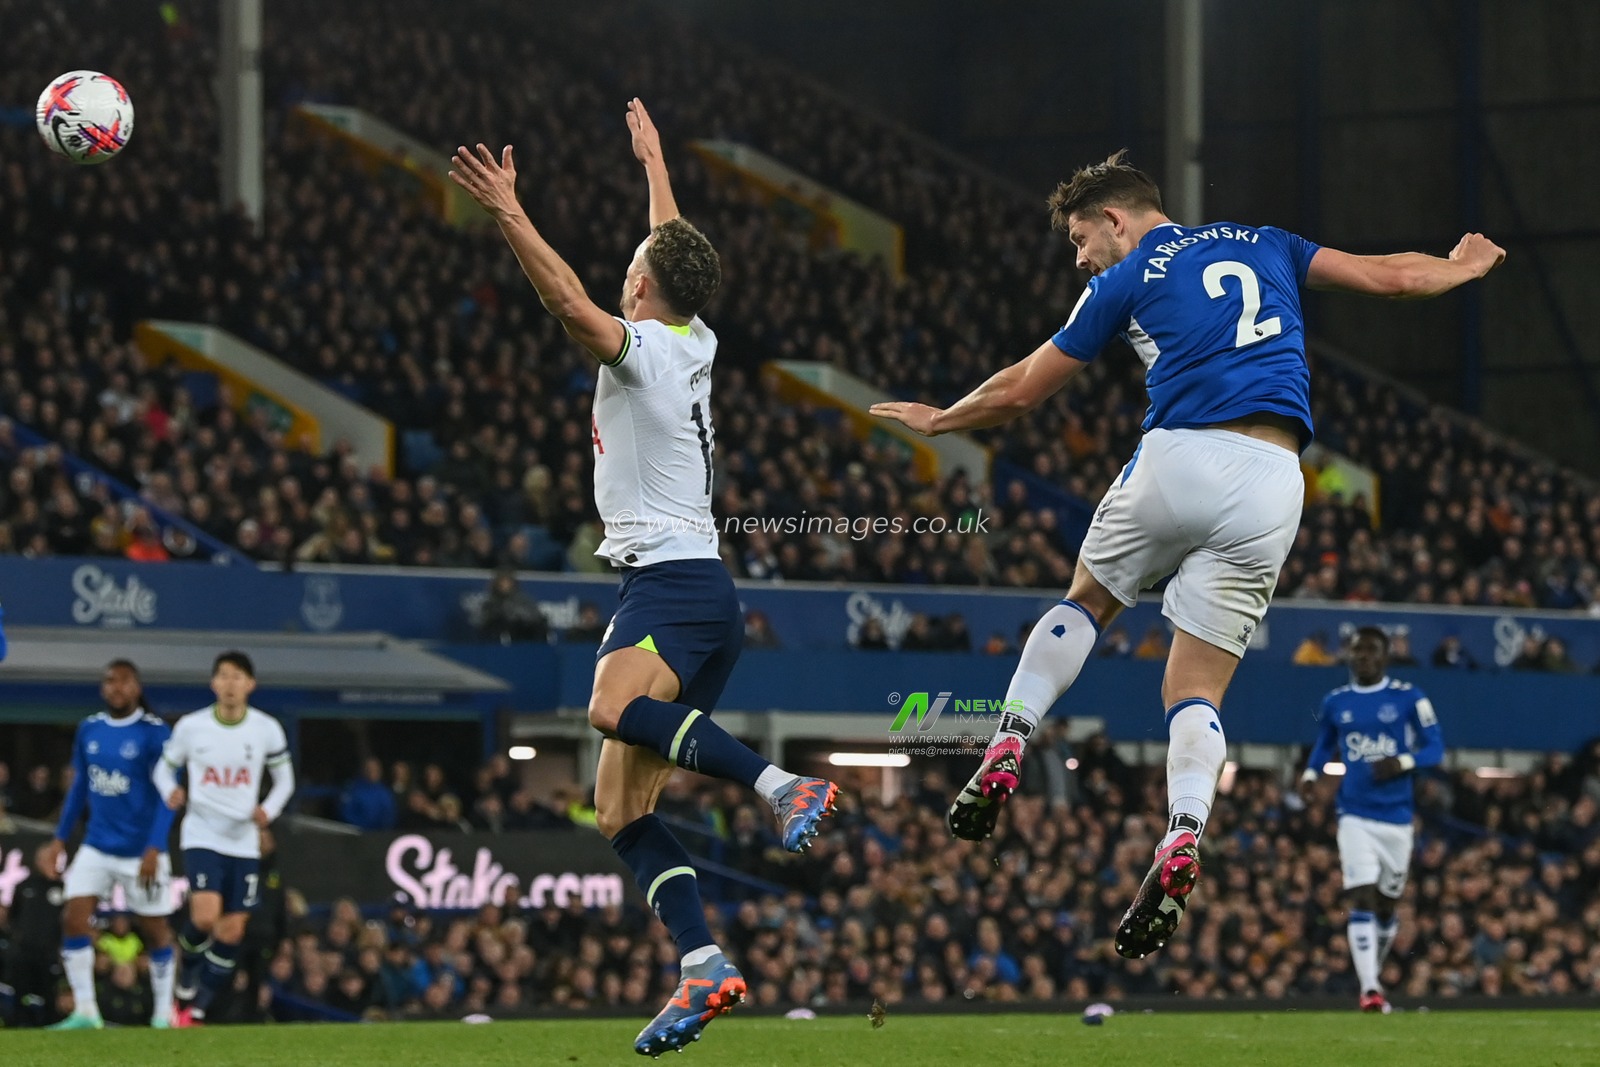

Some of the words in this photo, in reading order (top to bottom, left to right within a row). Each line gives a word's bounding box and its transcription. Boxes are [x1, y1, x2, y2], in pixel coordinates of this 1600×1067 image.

[1143, 226, 1259, 283] TARKOWSKI
[1203, 261, 1281, 348] 2
[203, 766, 251, 787] AIA
[385, 833, 624, 909] Stake.com
